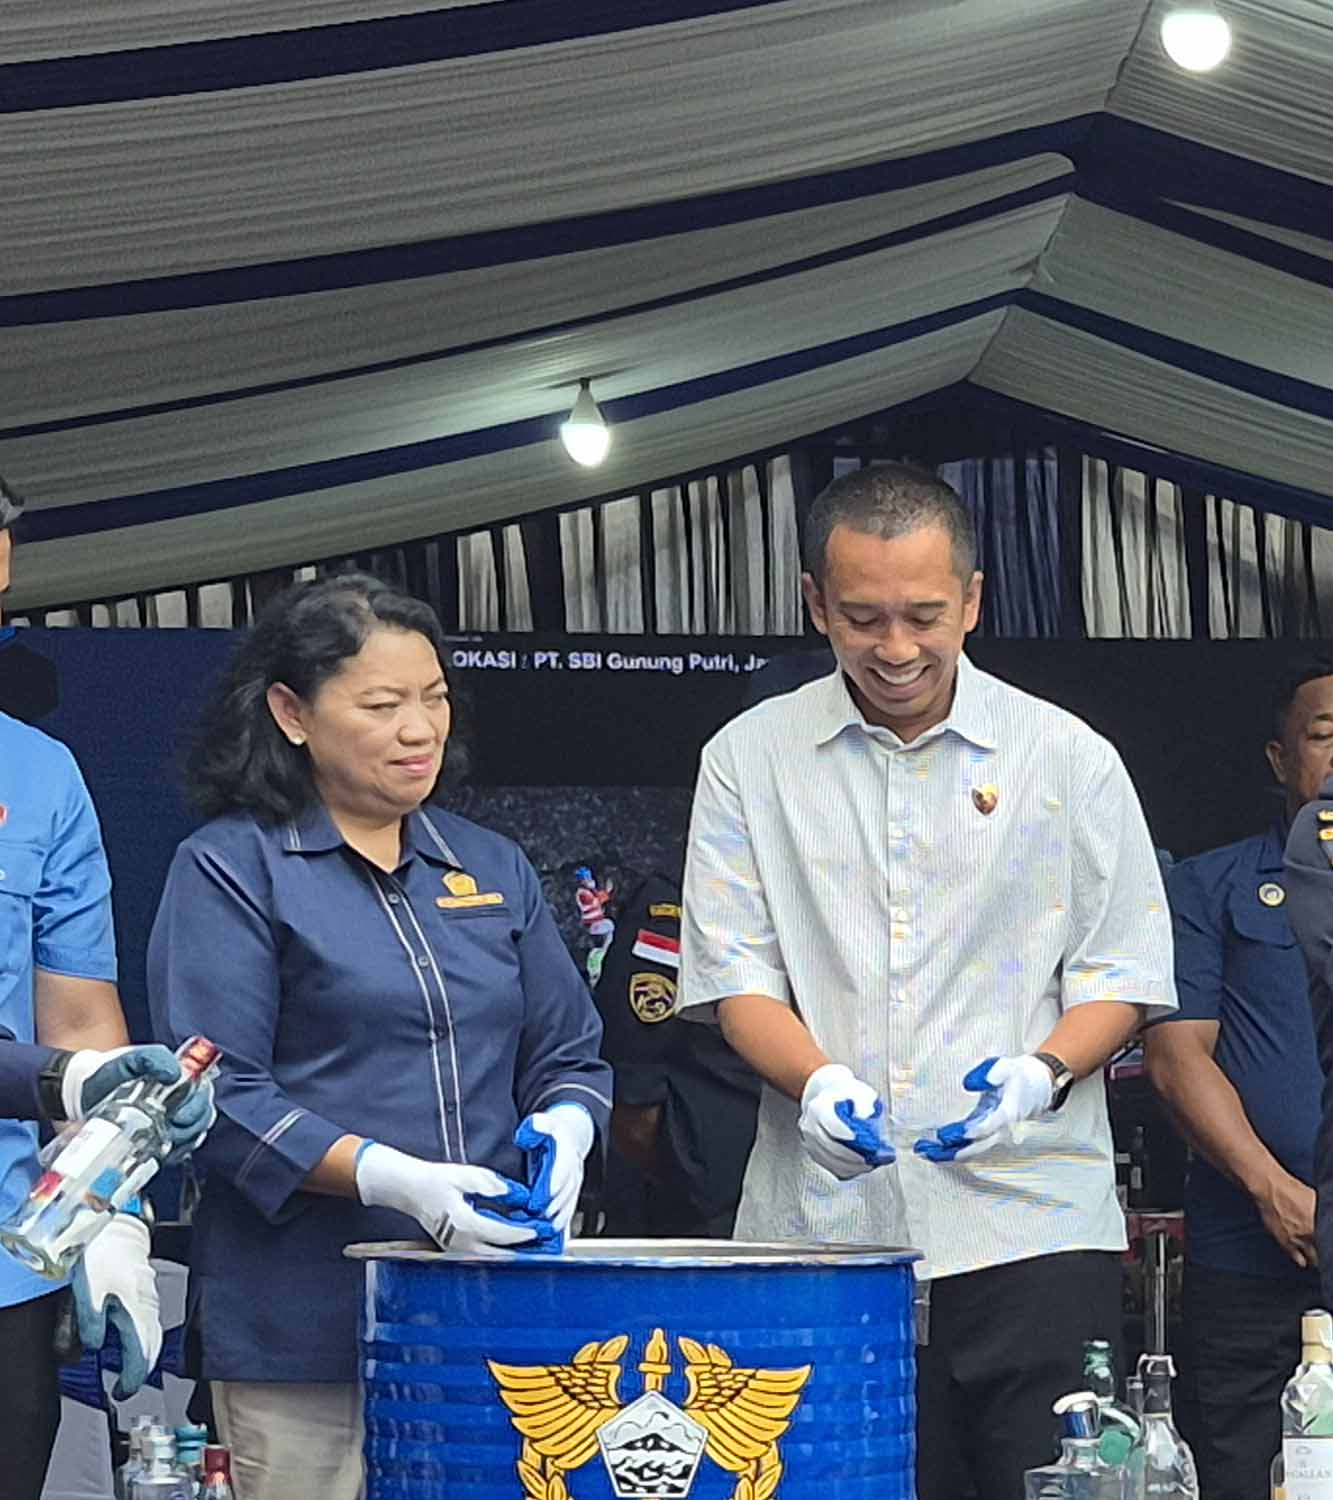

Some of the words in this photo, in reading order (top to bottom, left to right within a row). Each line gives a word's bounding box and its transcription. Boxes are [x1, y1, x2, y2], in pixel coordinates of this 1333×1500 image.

[452, 651, 516, 668] OKASI
[534, 652, 562, 669] PT.
[568, 652, 602, 669] SBI
[606, 652, 684, 674] Gunung
